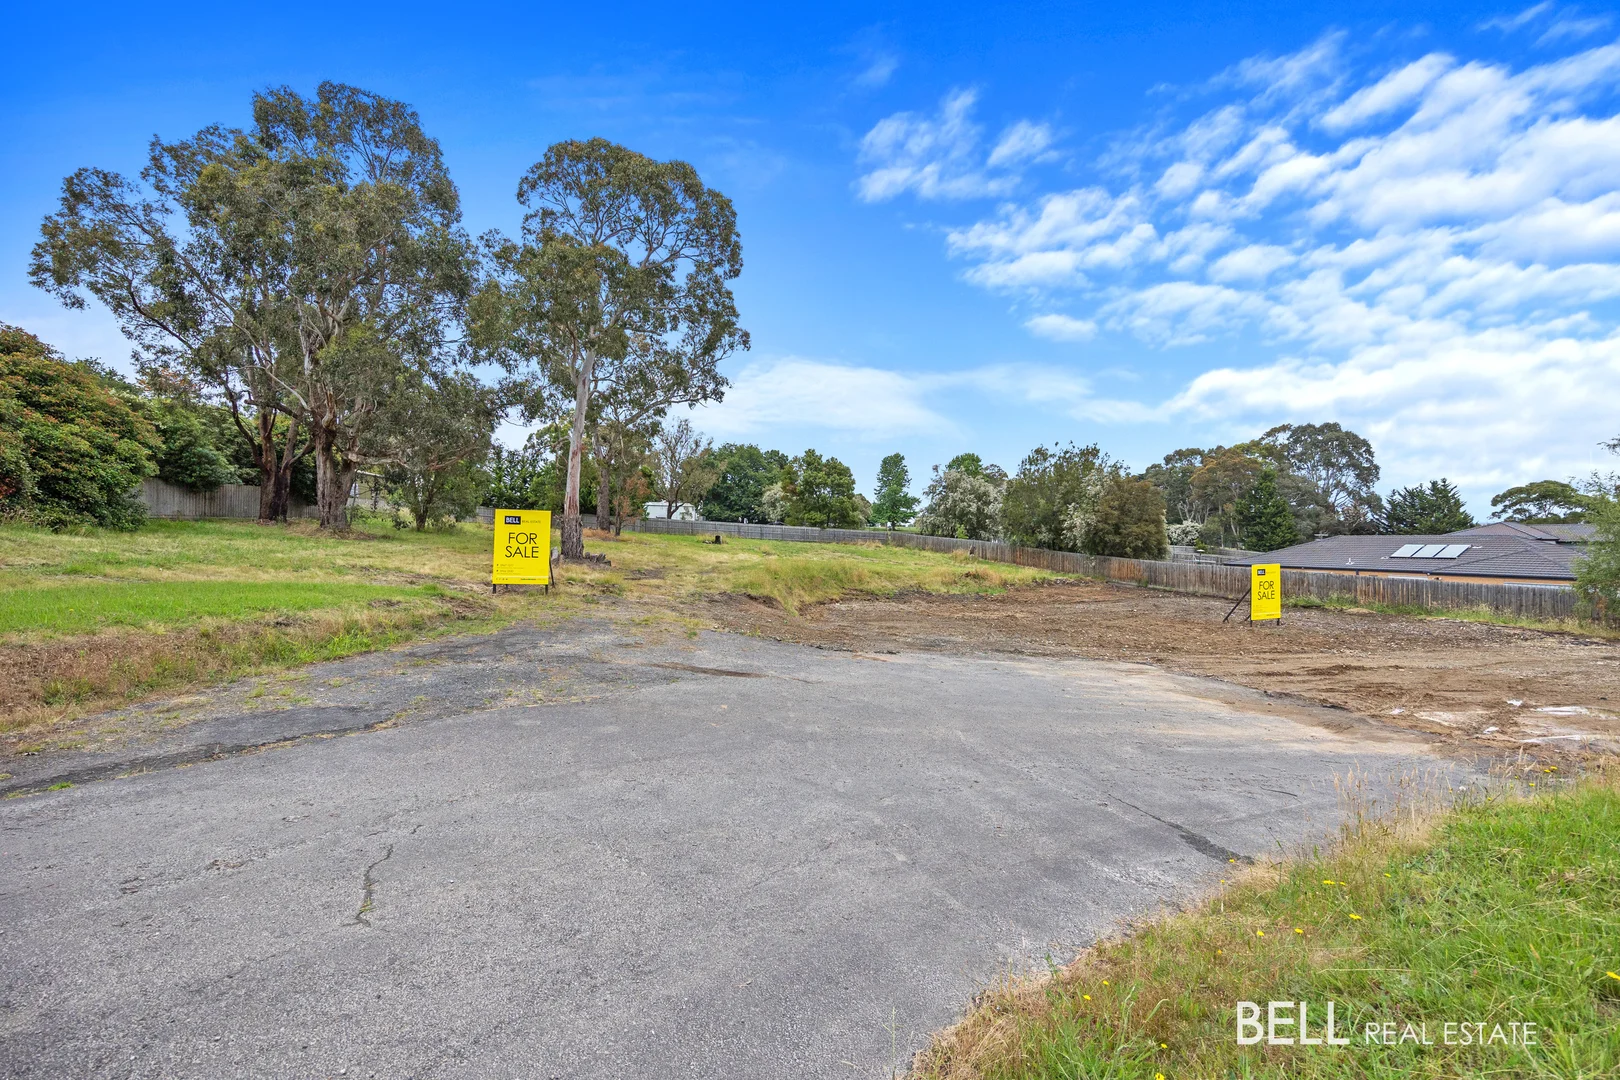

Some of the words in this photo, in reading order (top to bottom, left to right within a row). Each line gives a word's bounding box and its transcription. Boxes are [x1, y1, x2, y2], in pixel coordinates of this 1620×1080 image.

[508, 532, 537, 544] FOR
[505, 546, 539, 558] SALE
[1259, 581, 1274, 590] FOR
[1258, 590, 1275, 600] SALE
